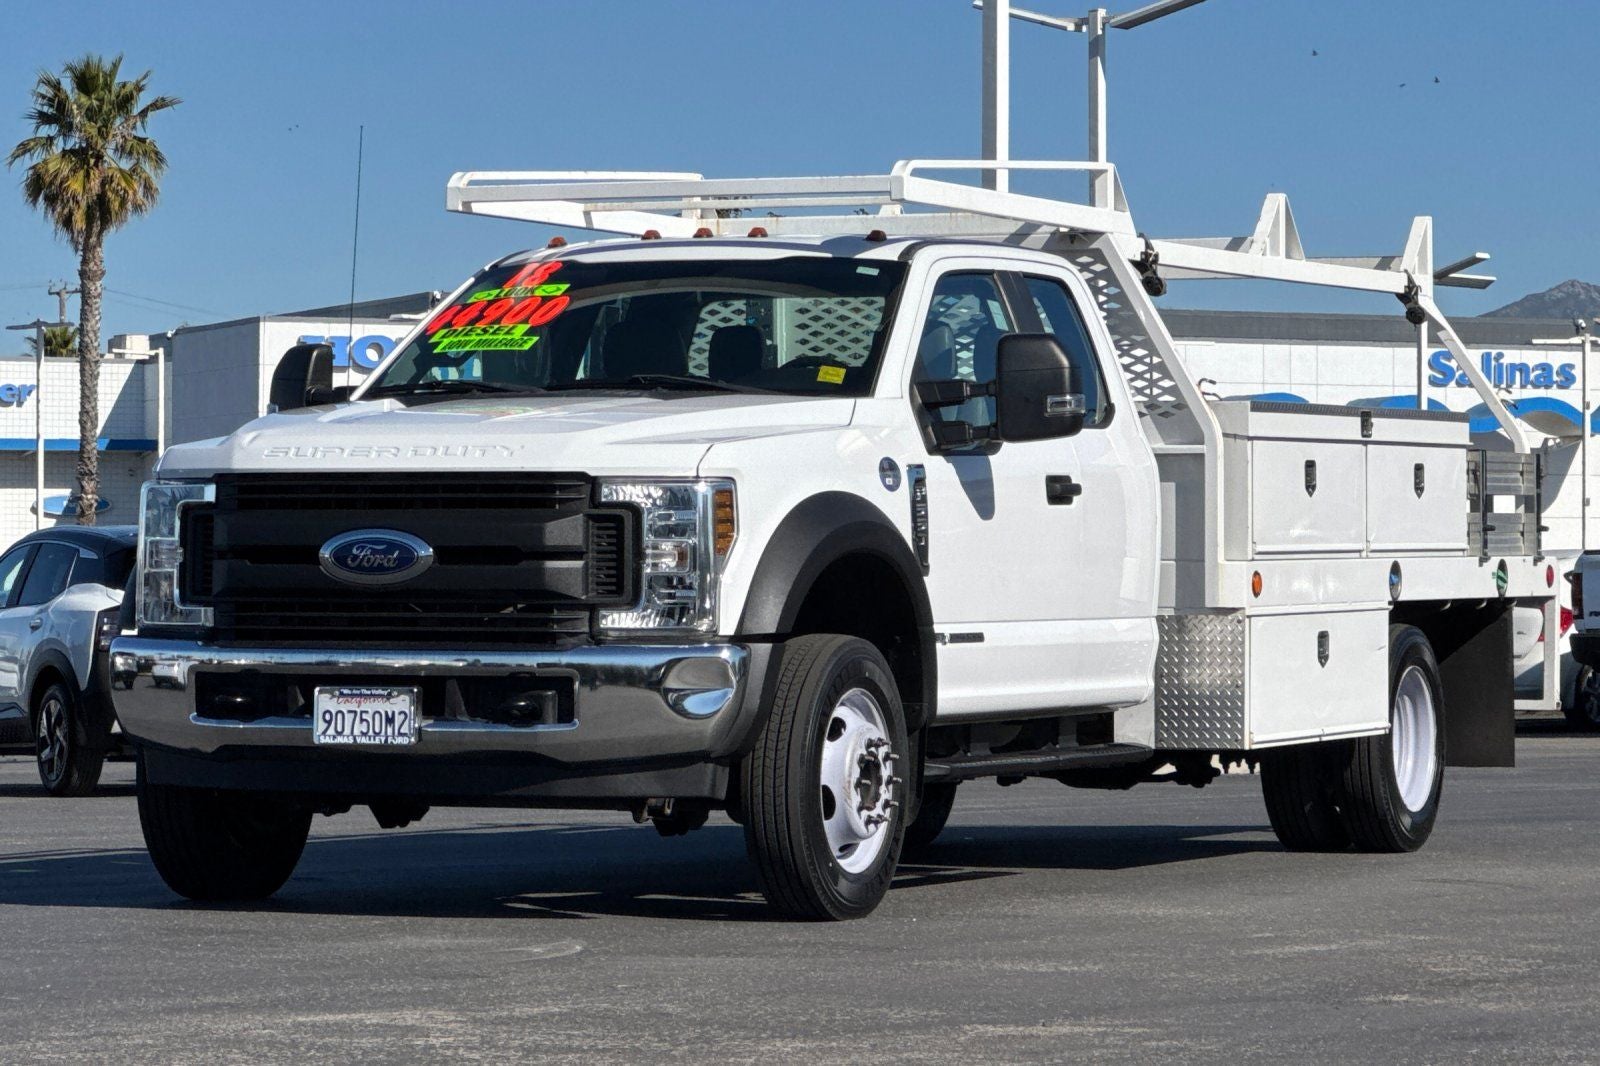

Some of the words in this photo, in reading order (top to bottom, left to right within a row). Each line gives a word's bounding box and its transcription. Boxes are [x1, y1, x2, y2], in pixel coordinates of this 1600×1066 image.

[502, 261, 563, 289] 18
[440, 325, 519, 339] DIESEL
[469, 337, 533, 349] MILEAGE
[262, 446, 400, 459] SUPER
[407, 445, 518, 458] DUTY
[347, 543, 400, 569] Ford
[321, 709, 409, 736] 90750M2
[320, 735, 354, 744] SALINAS
[356, 735, 386, 744] VALLEY
[387, 735, 410, 744] FORD
